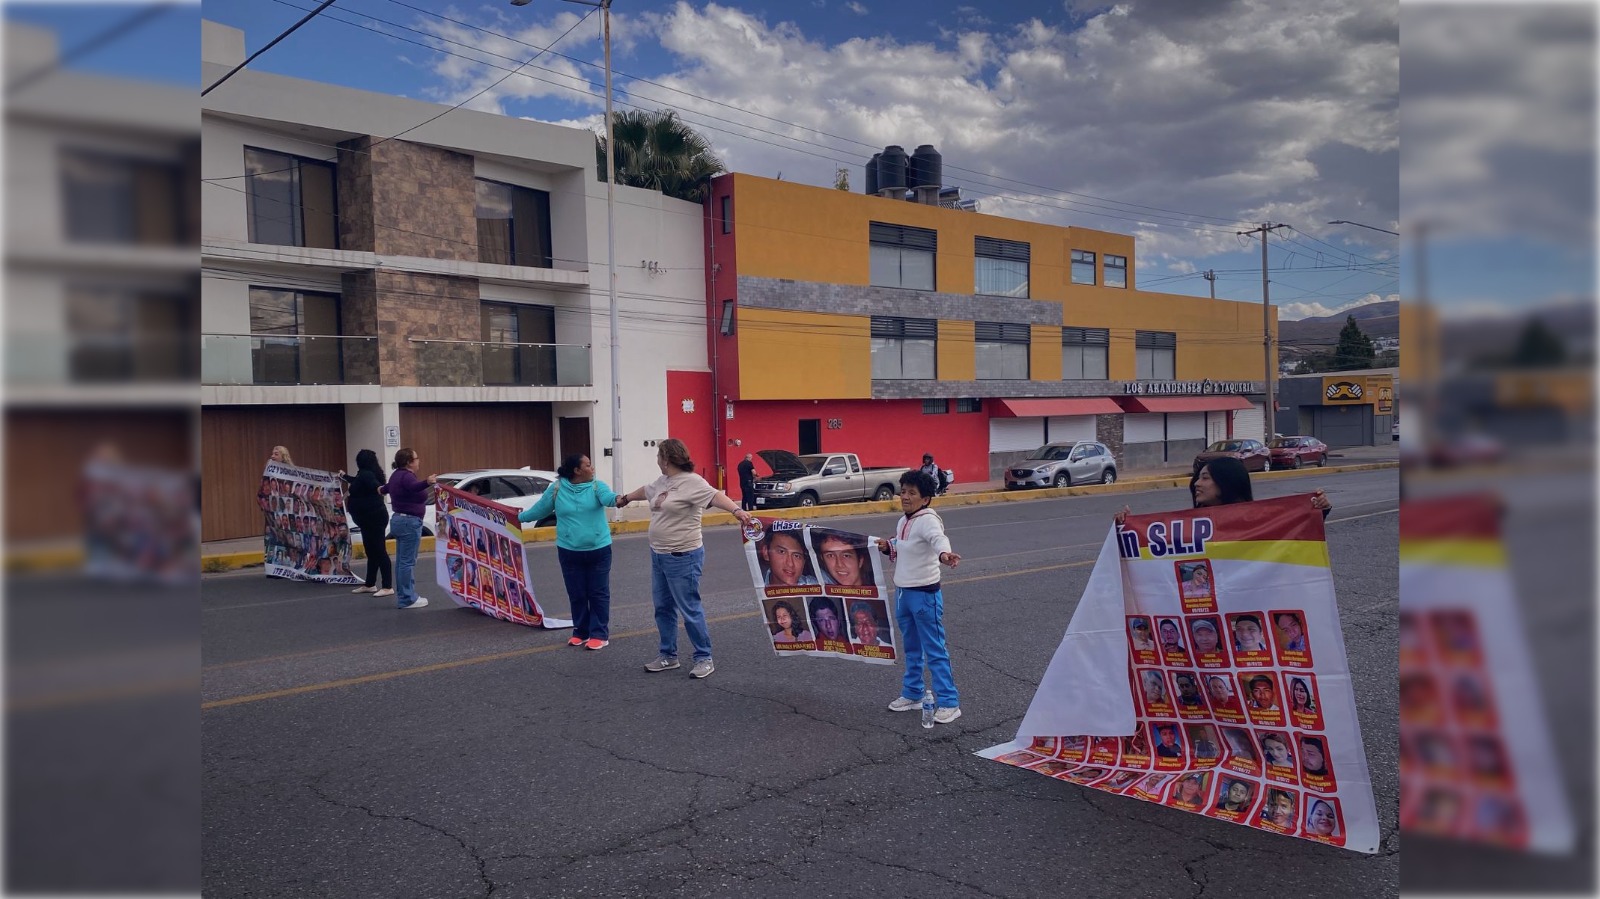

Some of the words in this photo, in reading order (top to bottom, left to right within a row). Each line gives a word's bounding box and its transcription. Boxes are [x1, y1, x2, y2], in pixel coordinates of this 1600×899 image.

[1125, 382, 1143, 394] LOS
[1147, 382, 1201, 393] ARANDENSES
[828, 418, 843, 429] 285
